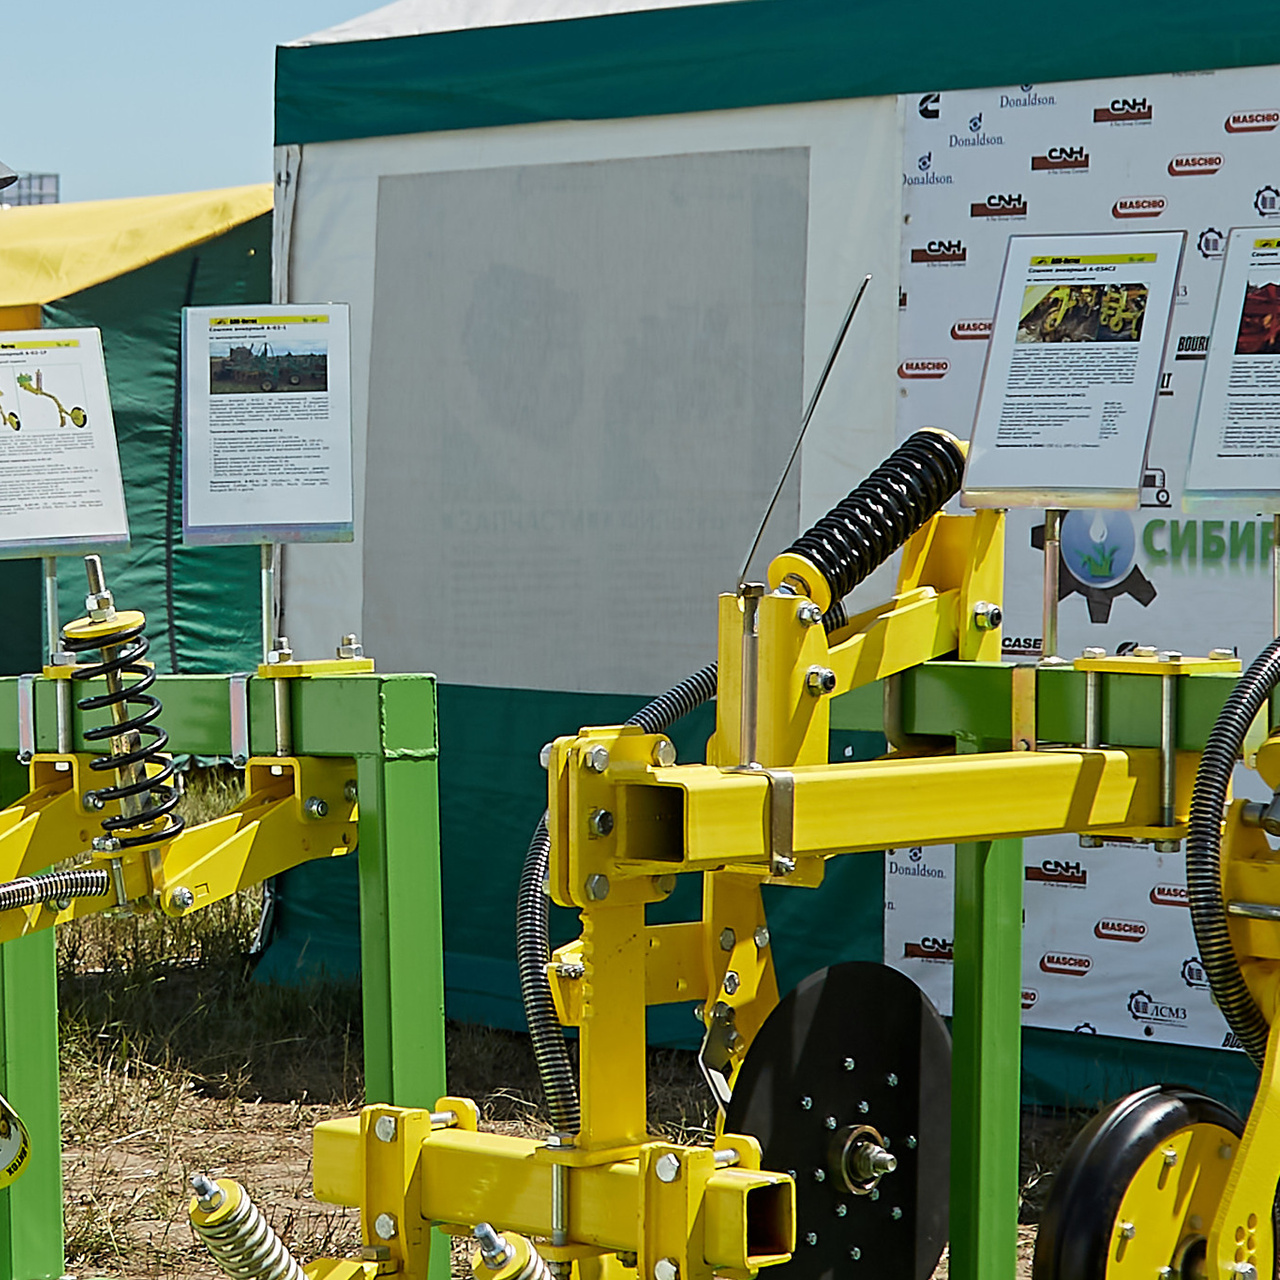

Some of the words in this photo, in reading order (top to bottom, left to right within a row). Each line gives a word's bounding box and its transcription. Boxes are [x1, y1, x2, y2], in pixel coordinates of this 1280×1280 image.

[1110, 97, 1147, 113] CNH
[1232, 111, 1280, 125] MASCHIO
[1048, 146, 1084, 161] CNH
[1174, 155, 1222, 168] MASCHIO
[986, 193, 1022, 208] CNH
[1119, 198, 1165, 211] MASCHIO
[927, 239, 962, 254] CNH
[905, 361, 949, 372] MASCHIO
[1001, 637, 1043, 650] CASE
[1041, 859, 1081, 876] CNH
[1101, 921, 1146, 936] MASCHIO
[1046, 954, 1091, 970] MASCHIO
